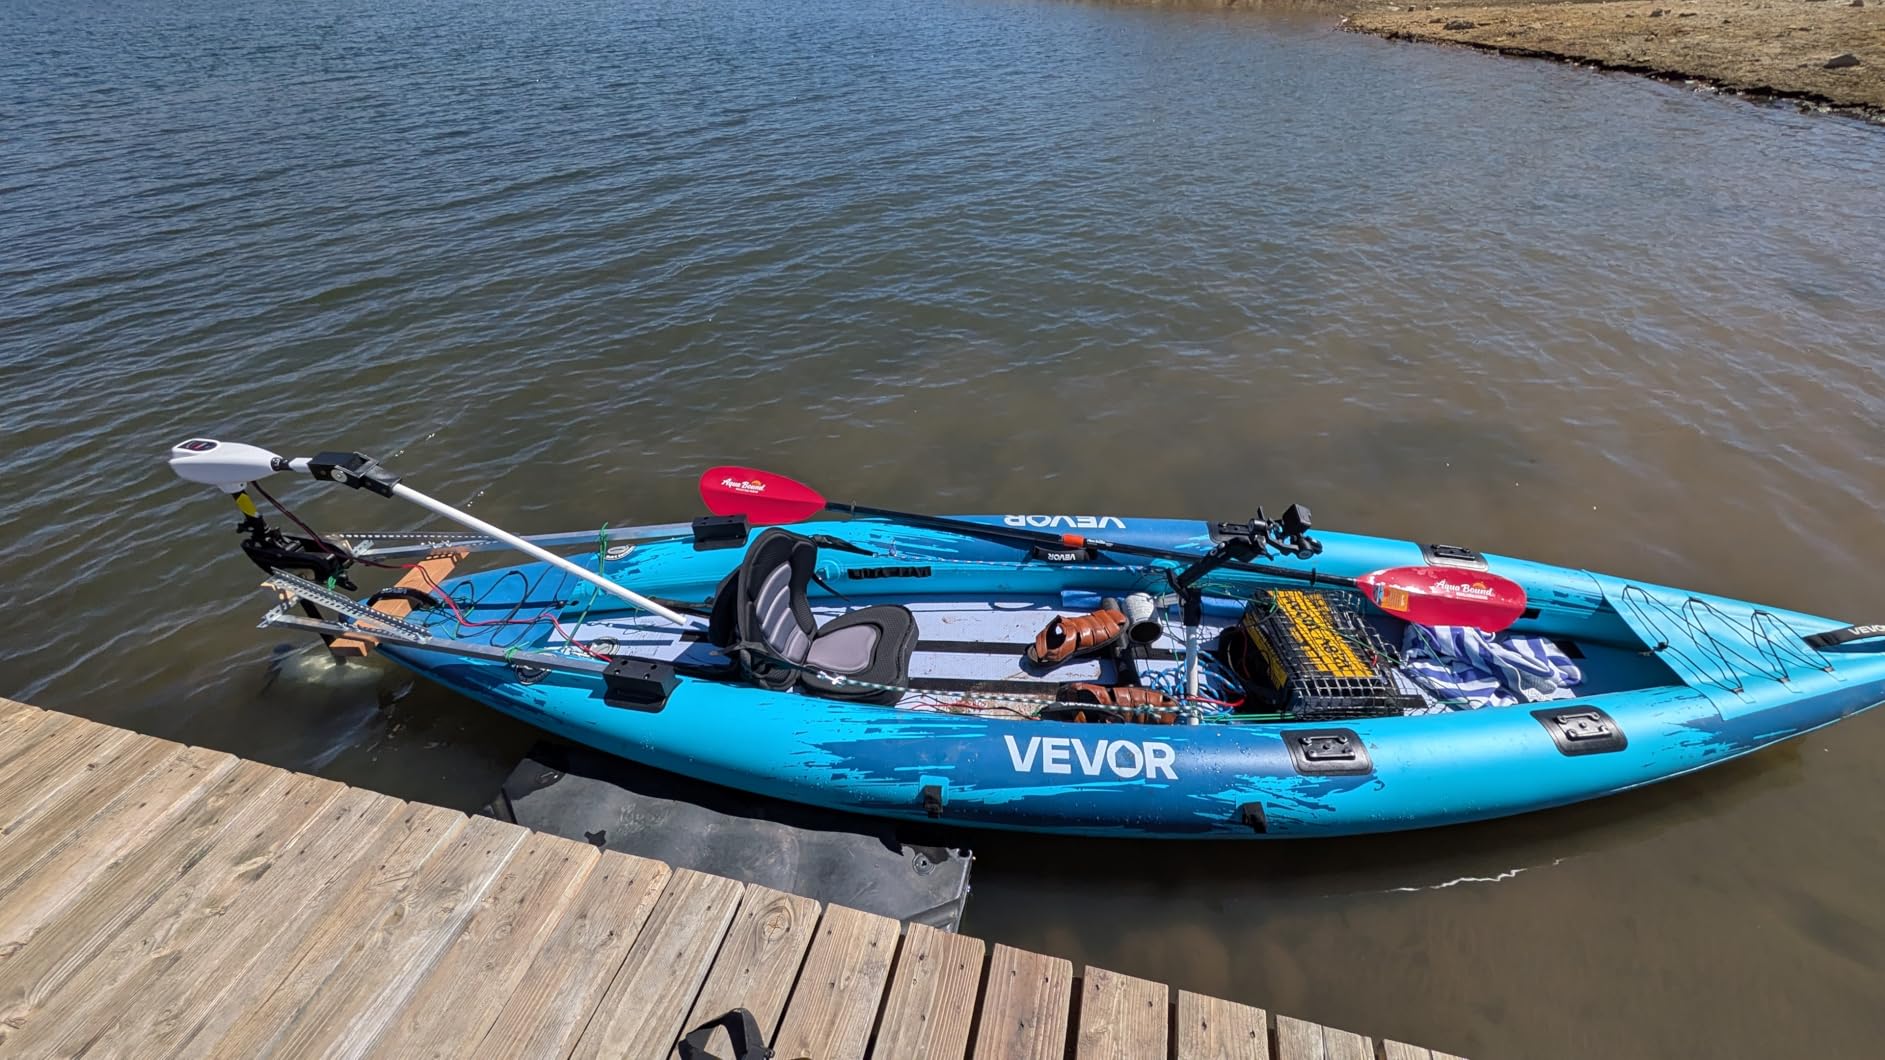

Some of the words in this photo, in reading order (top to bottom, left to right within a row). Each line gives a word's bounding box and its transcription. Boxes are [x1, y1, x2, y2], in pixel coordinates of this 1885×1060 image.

[721, 478, 741, 488] Aqua
[741, 481, 766, 491] Bound
[1003, 514, 1126, 528] VEVOR
[1048, 552, 1076, 561] VEVOR
[1435, 579, 1460, 591] Aqua
[1460, 583, 1496, 597] Bound
[1003, 735, 1179, 780] VEVOR
